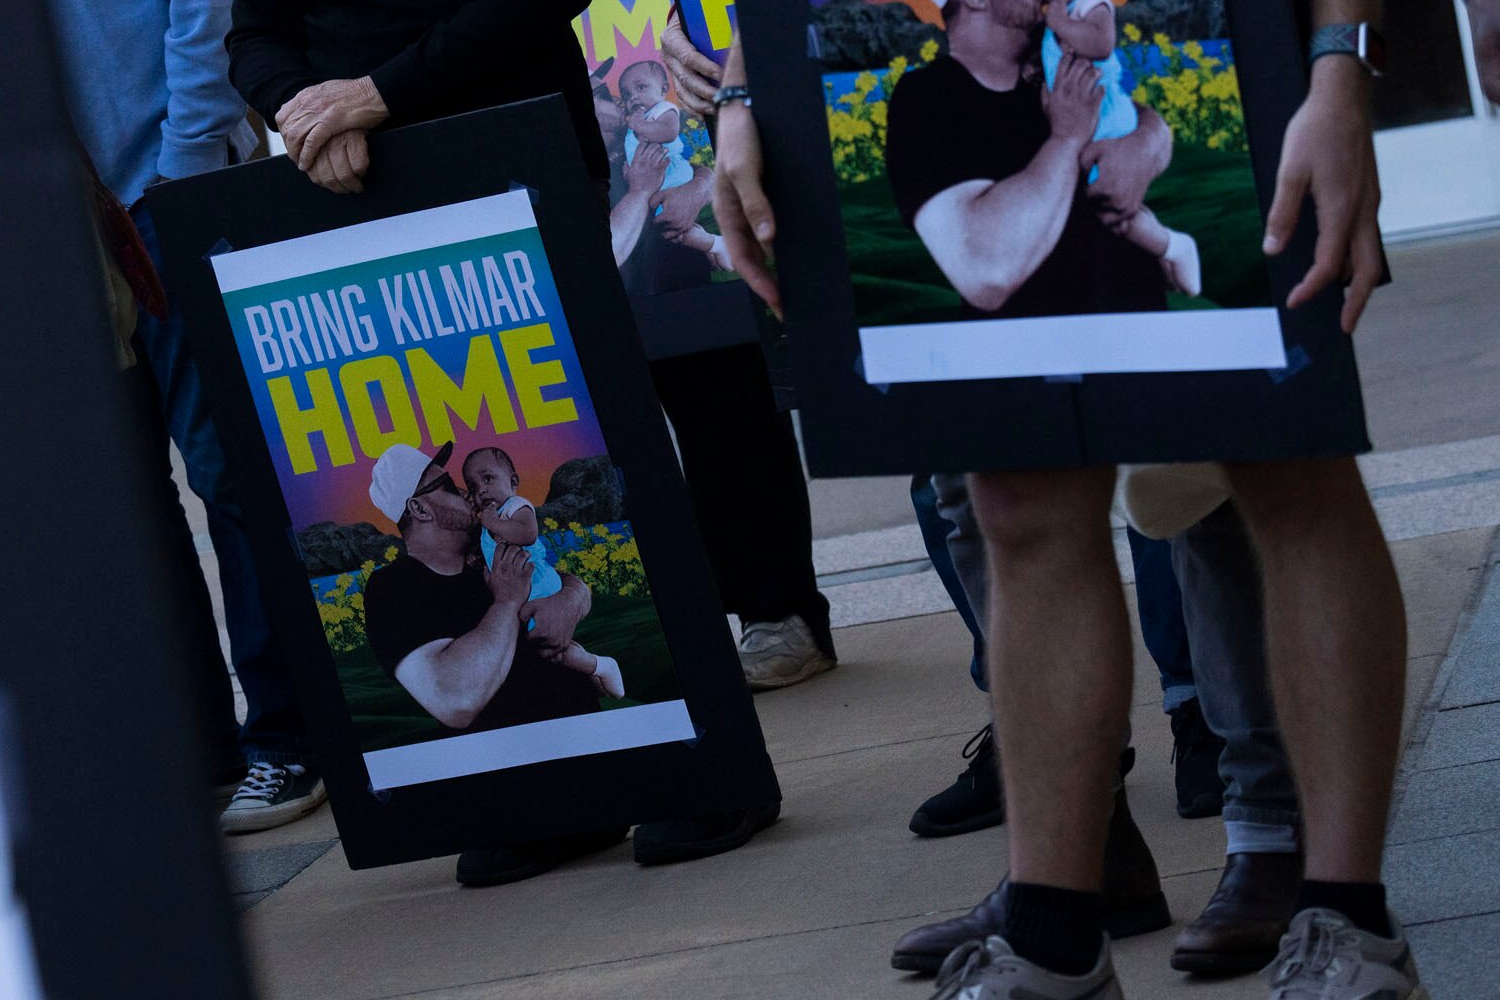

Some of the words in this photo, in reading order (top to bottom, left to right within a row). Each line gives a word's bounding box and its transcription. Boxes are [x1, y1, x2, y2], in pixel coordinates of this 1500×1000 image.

[244, 284, 379, 373] BRING
[378, 250, 546, 345] KILMAR
[266, 322, 579, 475] HOME
